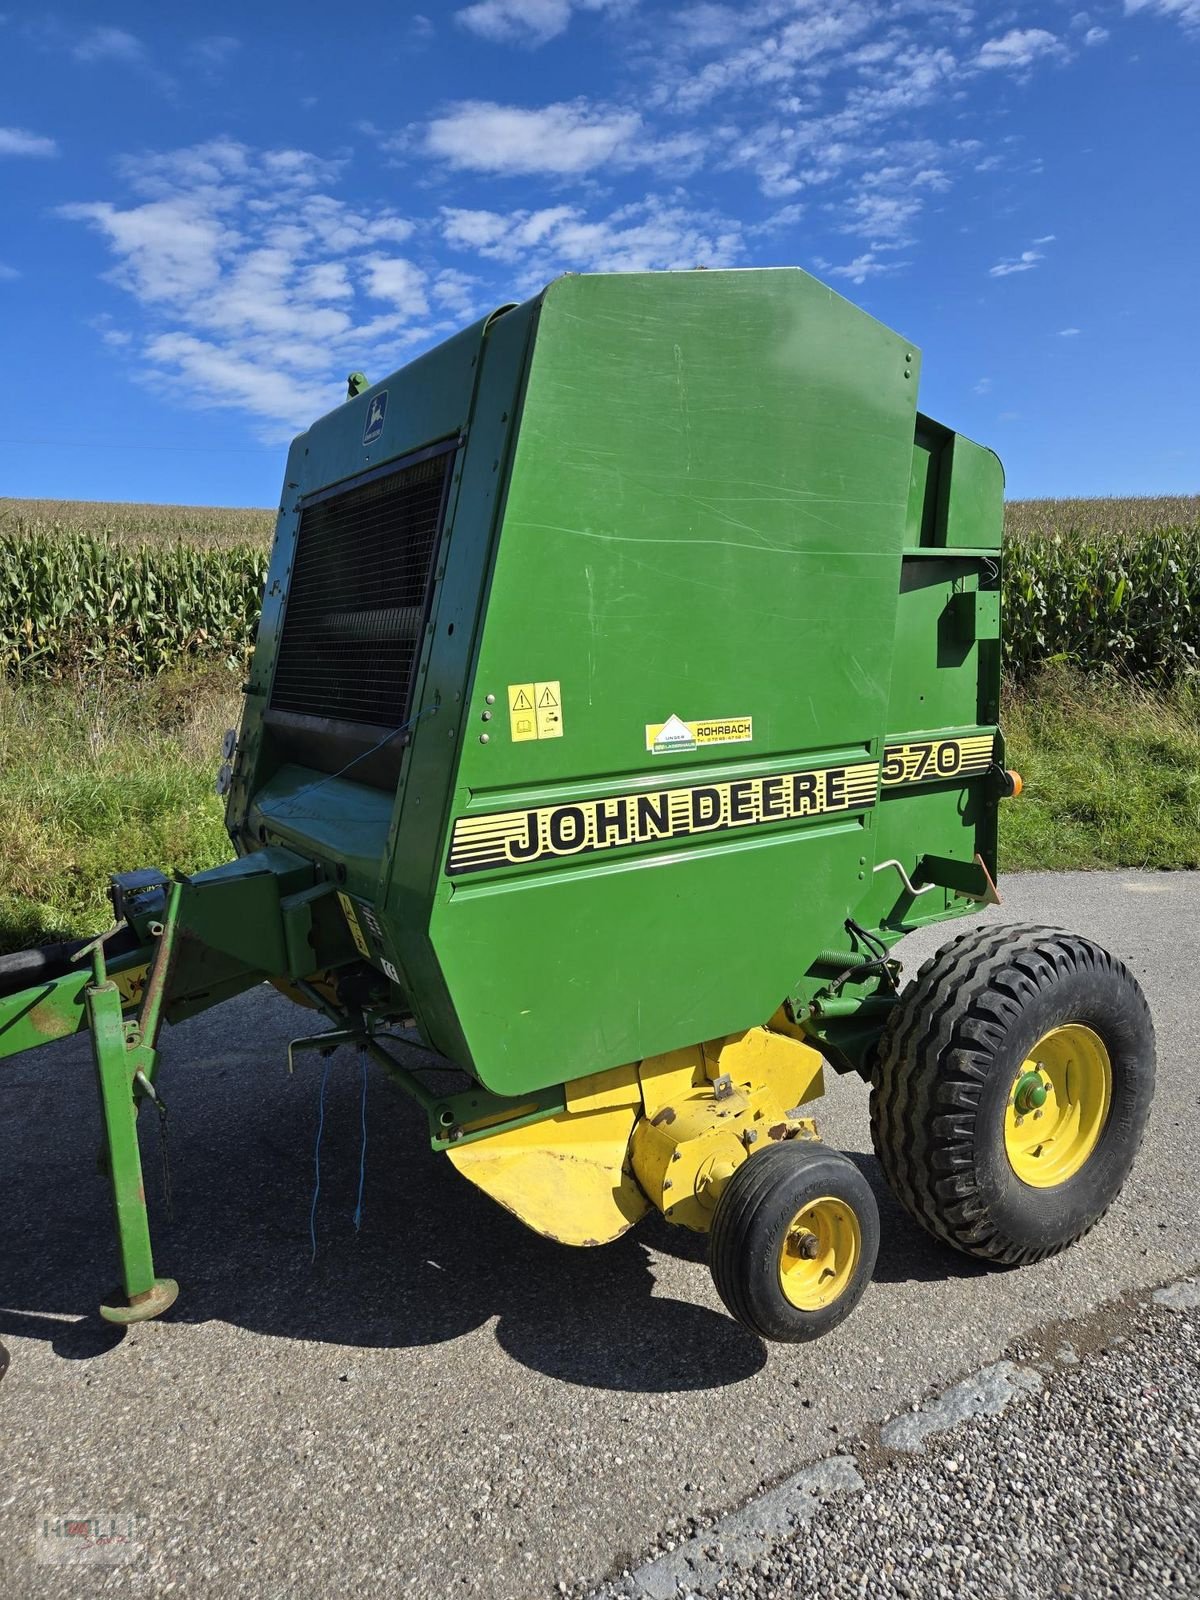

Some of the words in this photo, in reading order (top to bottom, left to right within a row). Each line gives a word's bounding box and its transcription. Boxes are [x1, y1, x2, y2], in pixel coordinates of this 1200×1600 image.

[697, 724, 751, 737] ROHRBACH
[881, 741, 961, 784] 570
[507, 792, 671, 860] JOHN
[689, 768, 848, 832] DEERE
